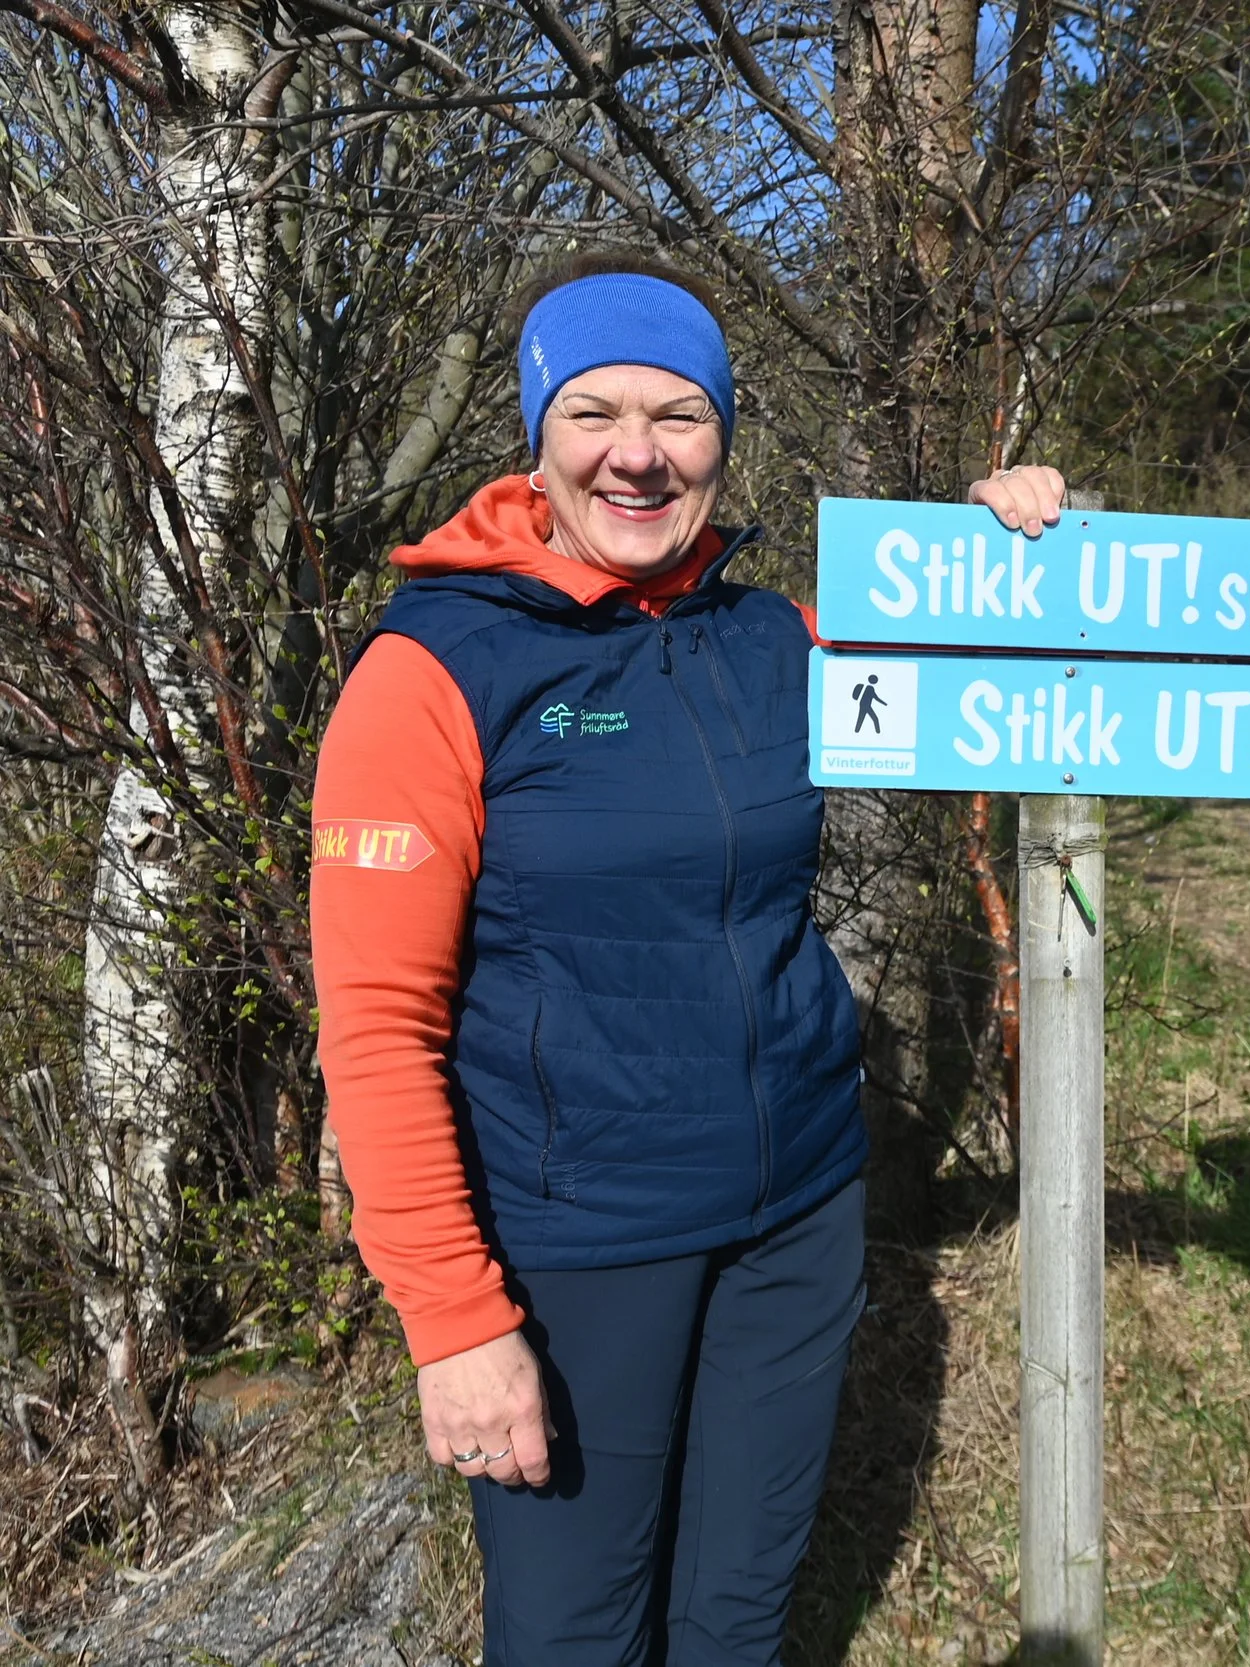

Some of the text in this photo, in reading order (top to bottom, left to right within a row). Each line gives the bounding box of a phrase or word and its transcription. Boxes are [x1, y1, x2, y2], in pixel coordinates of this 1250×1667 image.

[869, 528, 1045, 619] Stikk
[1078, 541, 1203, 628] UT!
[580, 709, 626, 721] Sunnmøre
[580, 719, 629, 736] friluftsråd
[953, 679, 1122, 766] Stikk
[826, 757, 911, 770] Vinterfottur
[313, 826, 411, 864] Stikk UT!
